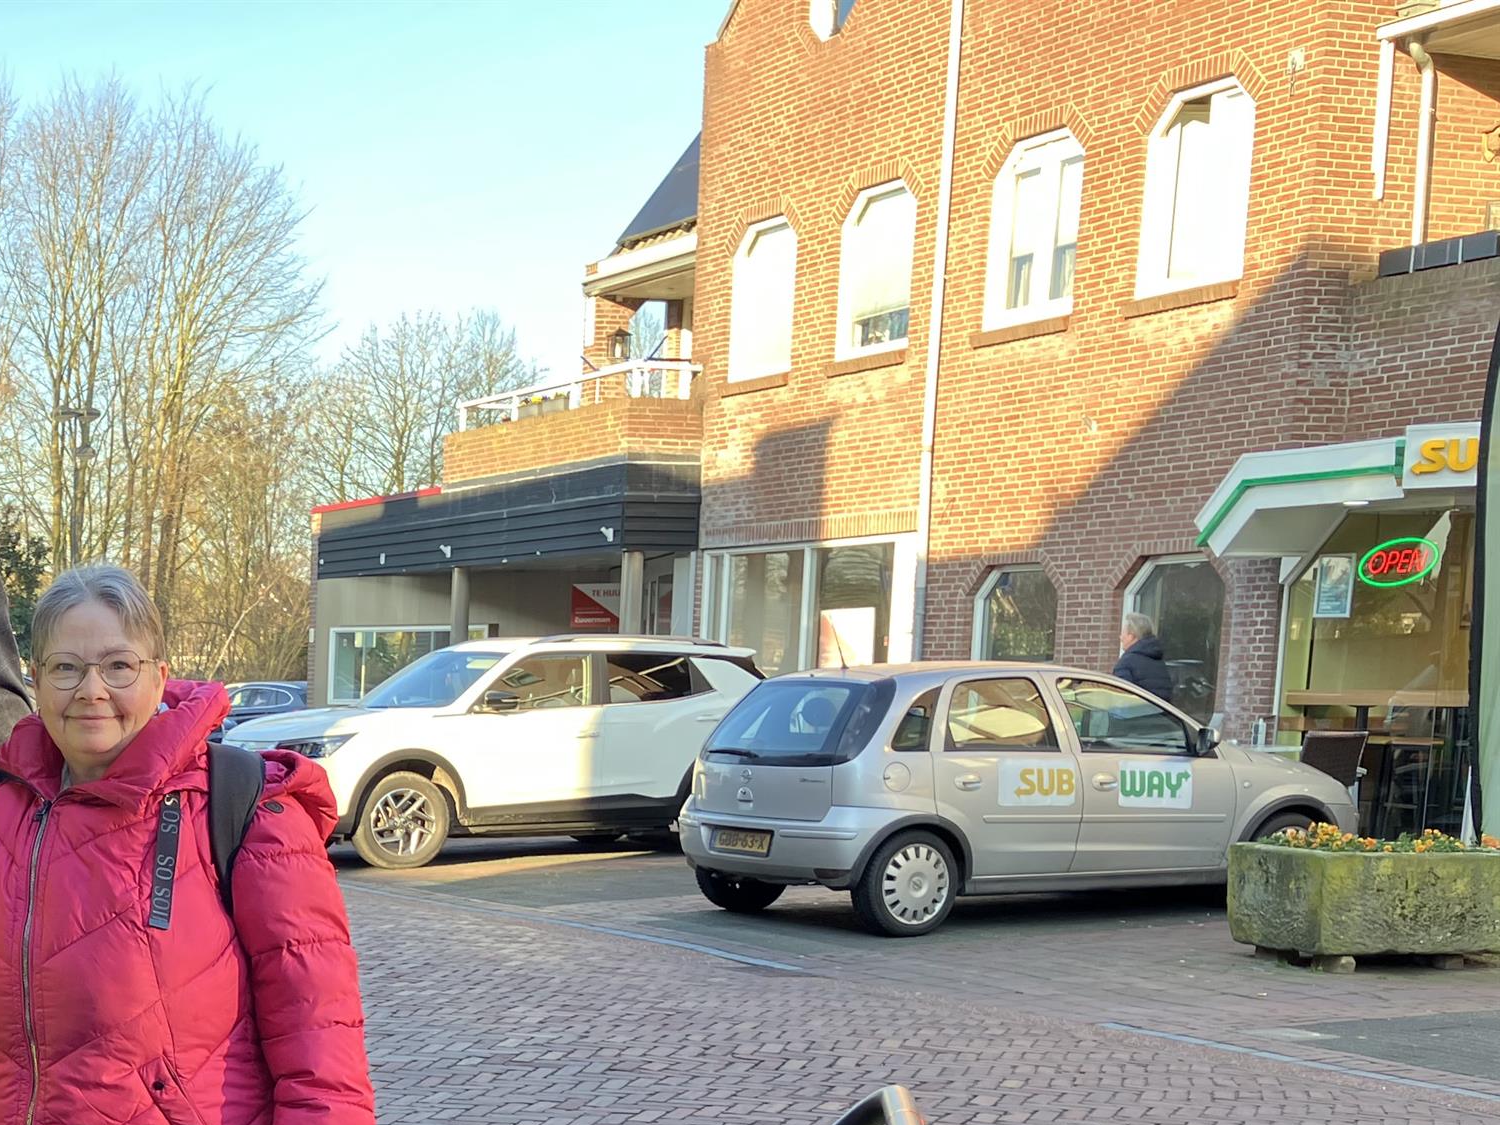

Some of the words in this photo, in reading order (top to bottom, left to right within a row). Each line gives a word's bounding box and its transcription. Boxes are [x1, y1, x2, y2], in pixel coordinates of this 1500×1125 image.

[1411, 437, 1479, 475] SU
[1368, 549, 1429, 576] OPEN
[1014, 768, 1076, 798] SUB
[1119, 769, 1192, 799] WAY
